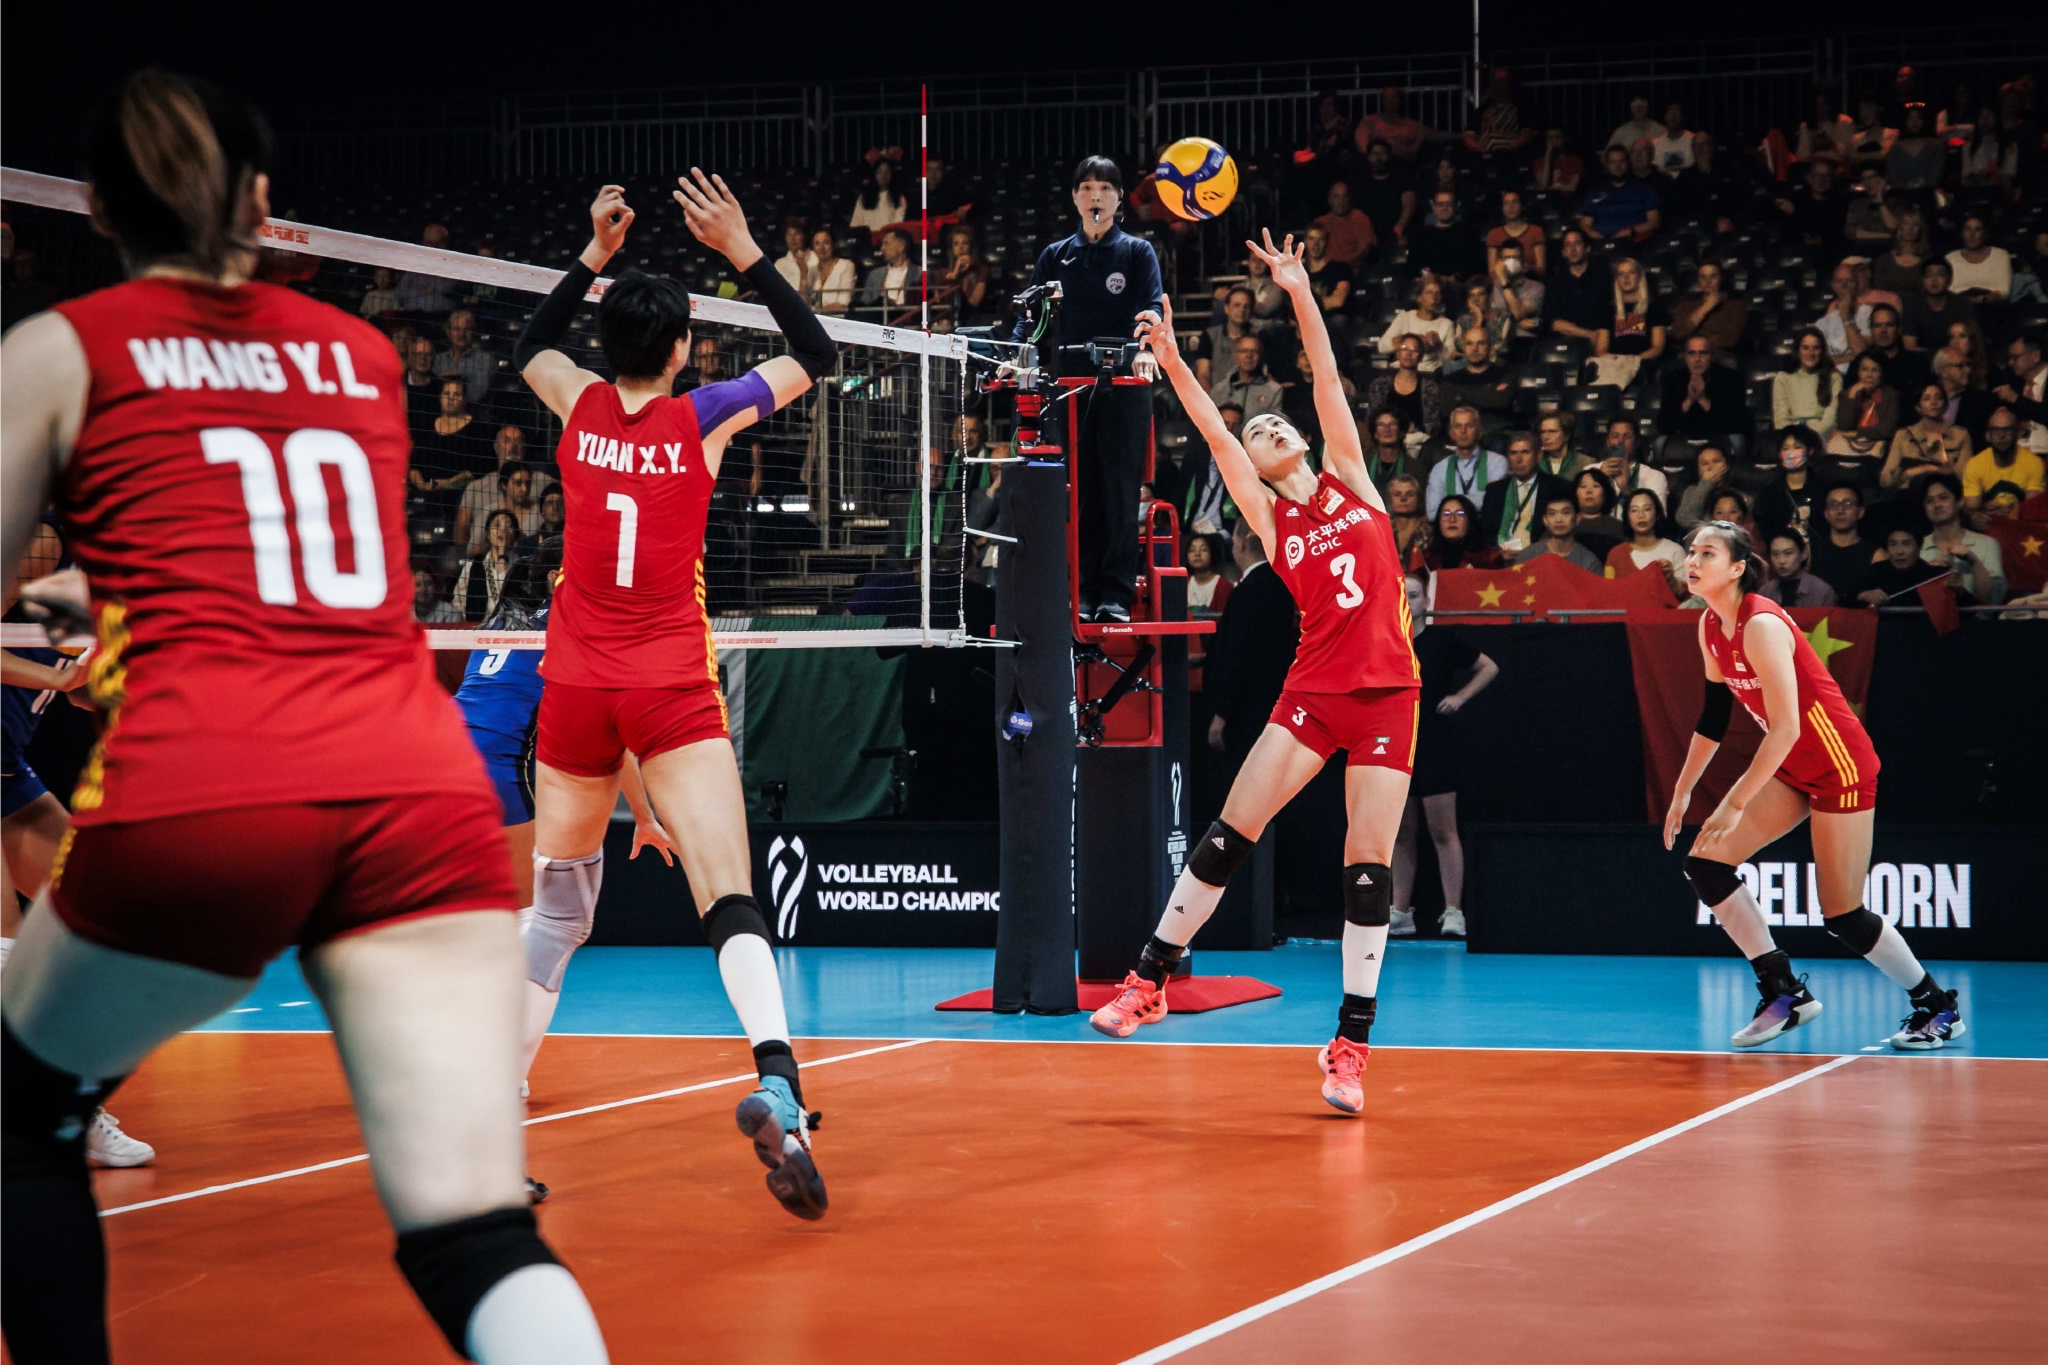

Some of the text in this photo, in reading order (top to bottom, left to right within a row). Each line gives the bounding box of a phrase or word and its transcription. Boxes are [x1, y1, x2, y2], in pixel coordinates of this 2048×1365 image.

[127, 336, 288, 393] WANG
[576, 430, 687, 475] YUAN X.Y.
[200, 426, 388, 609] 10
[1305, 507, 1373, 546] 太平洋保险
[606, 492, 638, 588] 1
[1310, 536, 1342, 556] CPIC
[1329, 553, 1364, 609] 3
[1291, 706, 1307, 726] 3
[817, 864, 958, 884] VOLLEYBALL
[817, 891, 899, 910] WORLD
